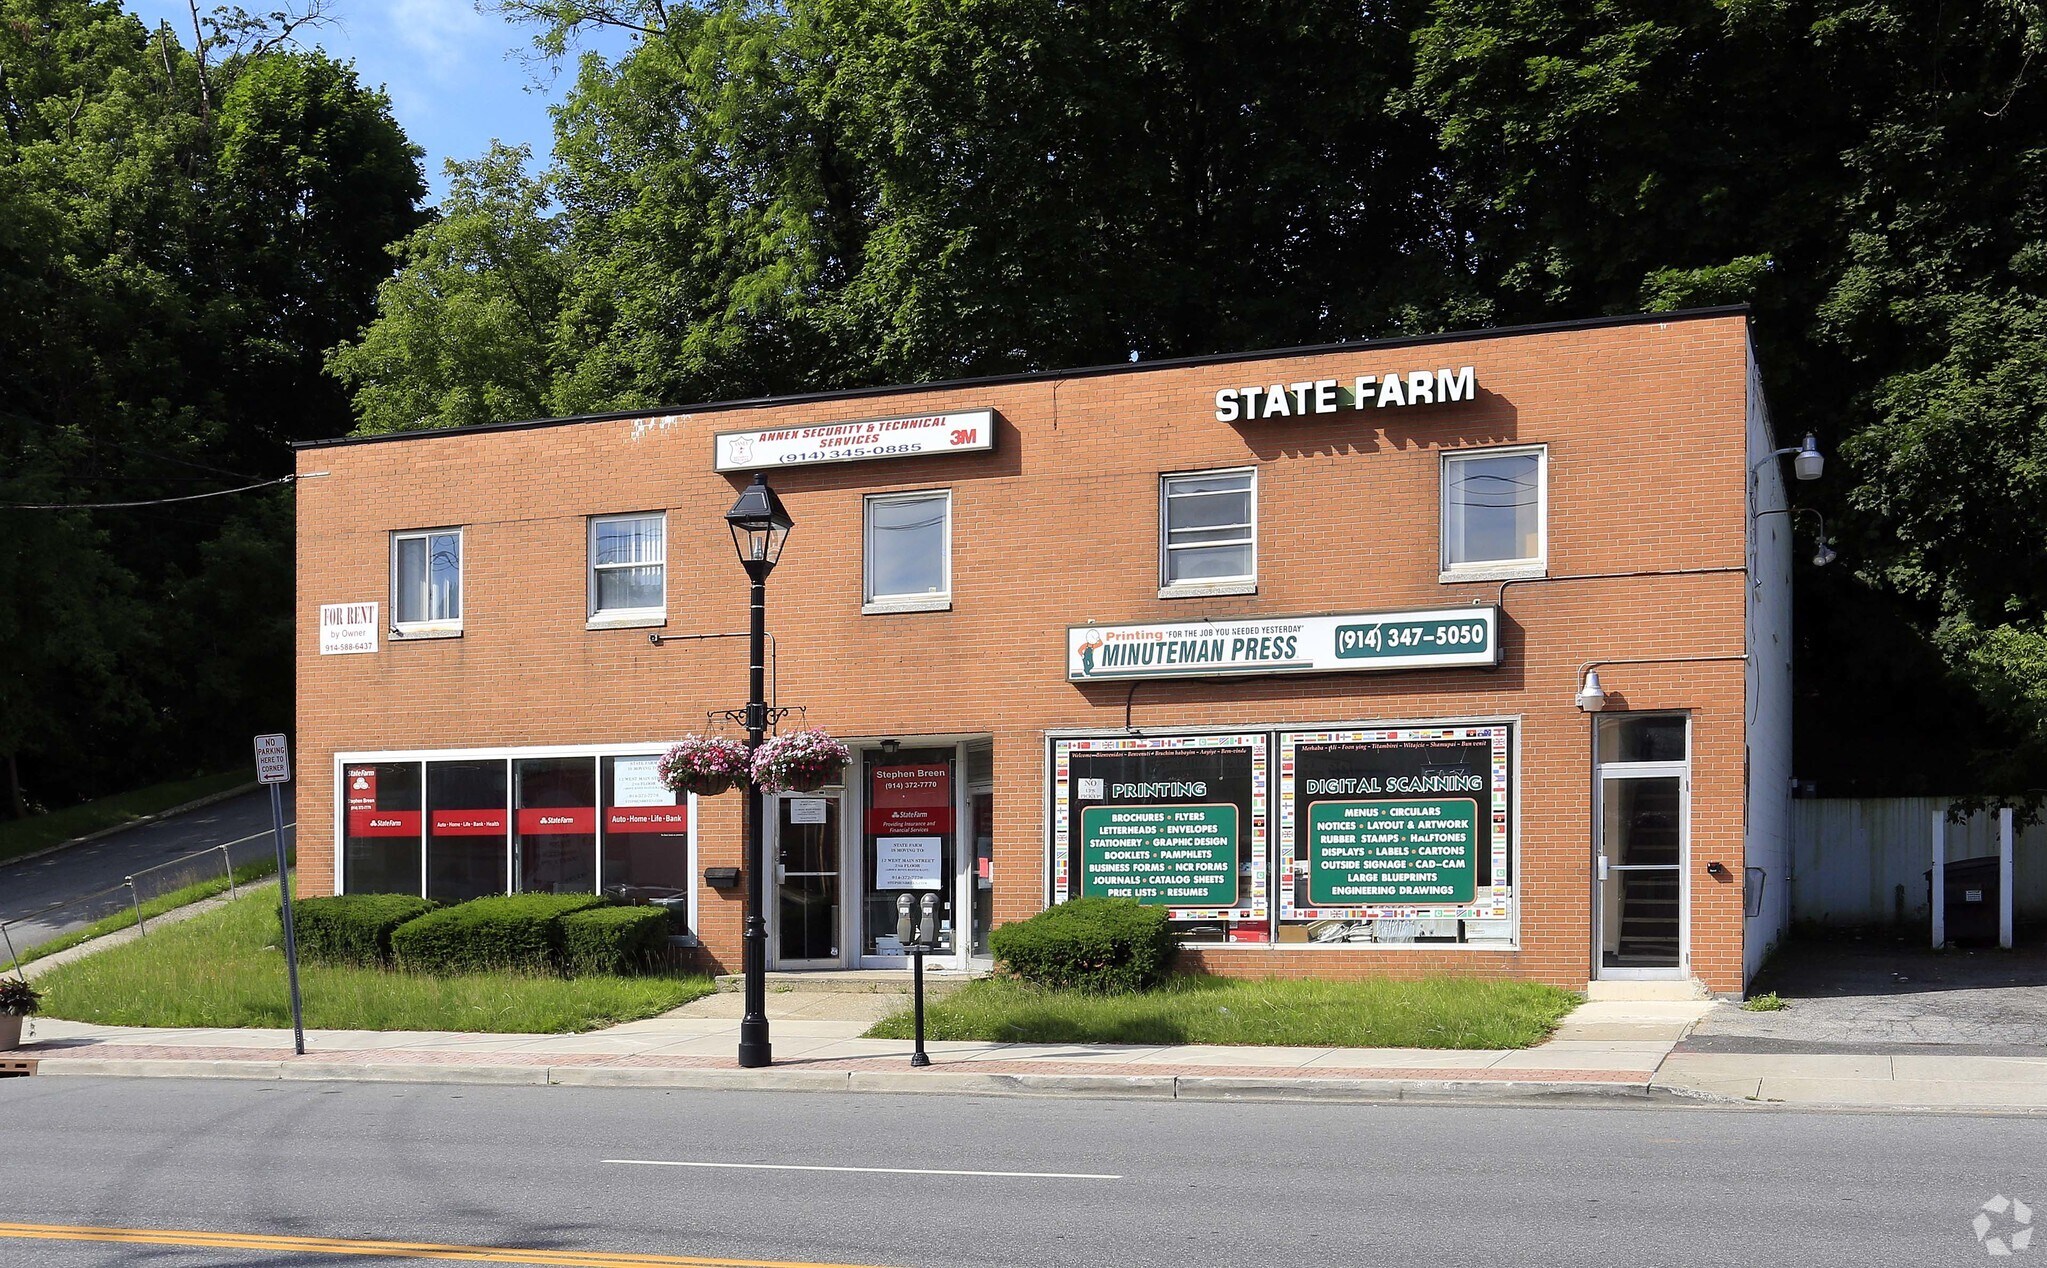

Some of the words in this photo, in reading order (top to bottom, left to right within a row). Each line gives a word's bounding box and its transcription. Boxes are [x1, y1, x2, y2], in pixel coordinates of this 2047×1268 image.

[1215, 379, 1337, 422] STATE
[1355, 366, 1475, 410] FARM
[759, 430, 799, 443] ANNEX
[802, 424, 863, 439] SECURITY
[867, 424, 875, 433] &
[879, 417, 947, 431] TECHNICAL
[820, 434, 880, 448] SERVICES
[950, 429, 977, 445] 3M
[779, 451, 825, 464] (914)
[829, 443, 922, 459] 345-0885
[325, 608, 343, 626] FOR
[348, 605, 375, 625] RENT
[331, 630, 340, 640] by
[342, 629, 366, 639] Owner
[1106, 630, 1162, 642] Printing
[1185, 629, 1197, 638] THE
[1200, 628, 1213, 637] JOB
[1216, 628, 1229, 636] YOU
[1232, 627, 1260, 636] NEEDED
[1339, 628, 1382, 654] (914)
[1387, 624, 1484, 647] 347-5050
[326, 642, 373, 652] 914-588-6437
[1102, 638, 1225, 667] MINUTEMAN
[1231, 635, 1297, 661] PRESS
[265, 738, 275, 747] NO
[258, 747, 284, 755] PARKING
[261, 756, 275, 764] HERE
[262, 765, 284, 773] CORNER
[877, 770, 914, 780] Stephen
[918, 769, 945, 778] Breen
[885, 782, 903, 791] (914)
[905, 781, 937, 789] 372-7770
[1112, 781, 1207, 798] PRINTING
[1306, 777, 1382, 794] DIGITAL
[1386, 775, 1484, 793] SCANNING
[900, 811, 927, 819] StateFarm
[1112, 813, 1165, 823] BROCHURES
[1175, 812, 1206, 822] FLYERS
[1344, 808, 1379, 817] MENUS
[1390, 807, 1442, 817] CIRCULARS
[612, 815, 626, 823] Auto
[630, 814, 647, 823] Home
[651, 814, 662, 822] Life
[665, 814, 682, 822] Bank
[1099, 825, 1158, 835] LETTERHEADS
[1167, 824, 1219, 834] ENVELOPES
[1317, 821, 1357, 831] NOTICES
[1367, 820, 1405, 830] LAYOUT
[1407, 820, 1415, 829] &
[1418, 819, 1469, 829] ARTWORK
[1090, 838, 1143, 848] STATIONERY
[1153, 837, 1193, 847] GRAPHIC
[1194, 836, 1228, 846] DESIGN
[1320, 834, 1356, 844] RUBBER
[1361, 833, 1399, 843] STAMPS
[1410, 833, 1467, 842] HALFTONES
[1104, 851, 1151, 860] BOOKLETS
[1160, 850, 1213, 859] PAMPHLETS
[1322, 847, 1365, 857] DISPLAYS
[1375, 846, 1410, 856] LABELS
[1418, 846, 1466, 855] CARTONS
[1089, 863, 1131, 873] BUSINESS
[1133, 863, 1166, 872] FORMS
[1175, 862, 1194, 872] NCR
[1195, 862, 1228, 872] FORMS
[1321, 860, 1360, 870] OUTSIDE
[1363, 860, 1407, 869] SIGNAGE
[1415, 859, 1466, 868] CAD-CAM
[1093, 875, 1141, 885] JOURNALS
[1149, 875, 1191, 884] CATALOG
[1193, 874, 1225, 884] SHEETS
[1348, 873, 1378, 882] LARGE
[1381, 872, 1438, 882] BLUEPRINTS
[1108, 888, 1132, 898] PRICE
[1135, 888, 1157, 897] LISTS
[1167, 887, 1209, 897] RESUMES
[1332, 886, 1397, 895] ENGINEERING
[1399, 885, 1454, 895] DRAWINGS
